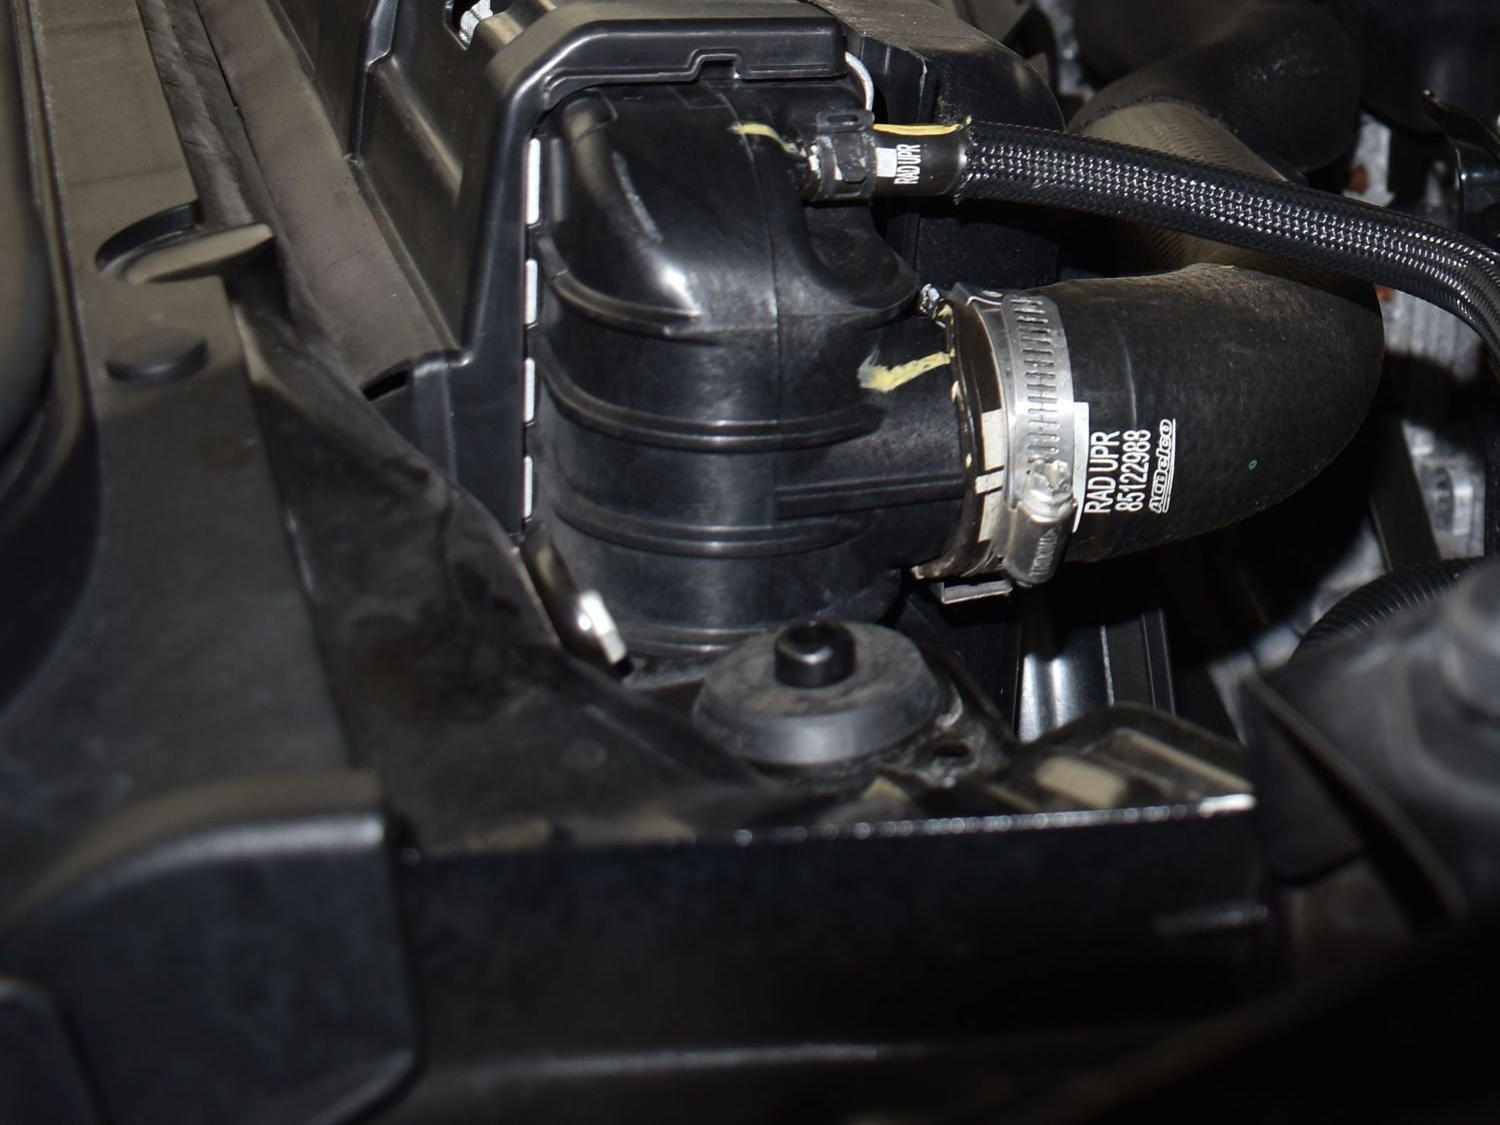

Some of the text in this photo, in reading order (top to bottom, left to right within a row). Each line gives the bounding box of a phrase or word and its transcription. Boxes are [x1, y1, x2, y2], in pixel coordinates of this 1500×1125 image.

[893, 143, 921, 184] RAD UPR
[1084, 430, 1120, 514] RAD UPR
[1114, 429, 1151, 512] 85122988
